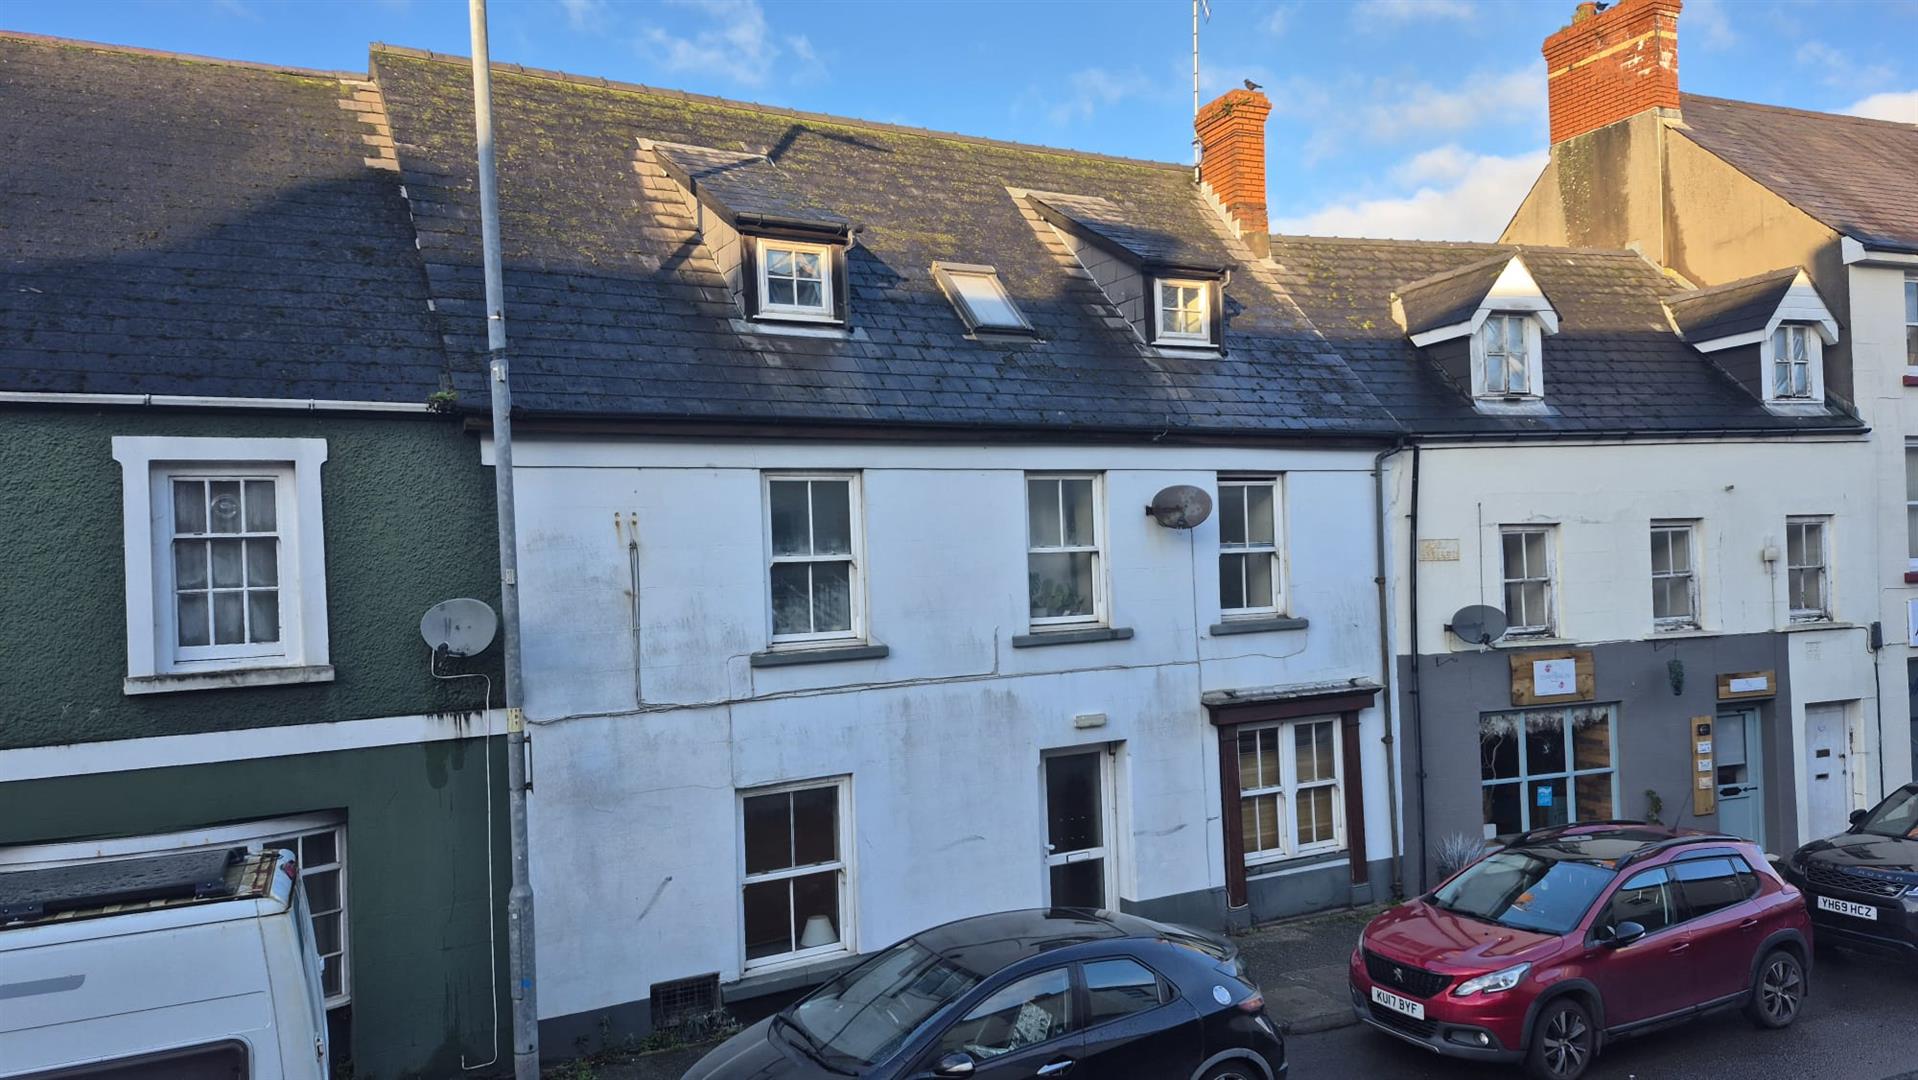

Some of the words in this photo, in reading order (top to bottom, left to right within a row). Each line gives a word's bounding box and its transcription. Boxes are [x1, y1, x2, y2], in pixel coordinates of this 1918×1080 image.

[1822, 897, 1848, 912] YH69
[1850, 903, 1872, 917] HCZ
[1376, 989, 1397, 1007] KU17
[1399, 998, 1418, 1014] BYF
